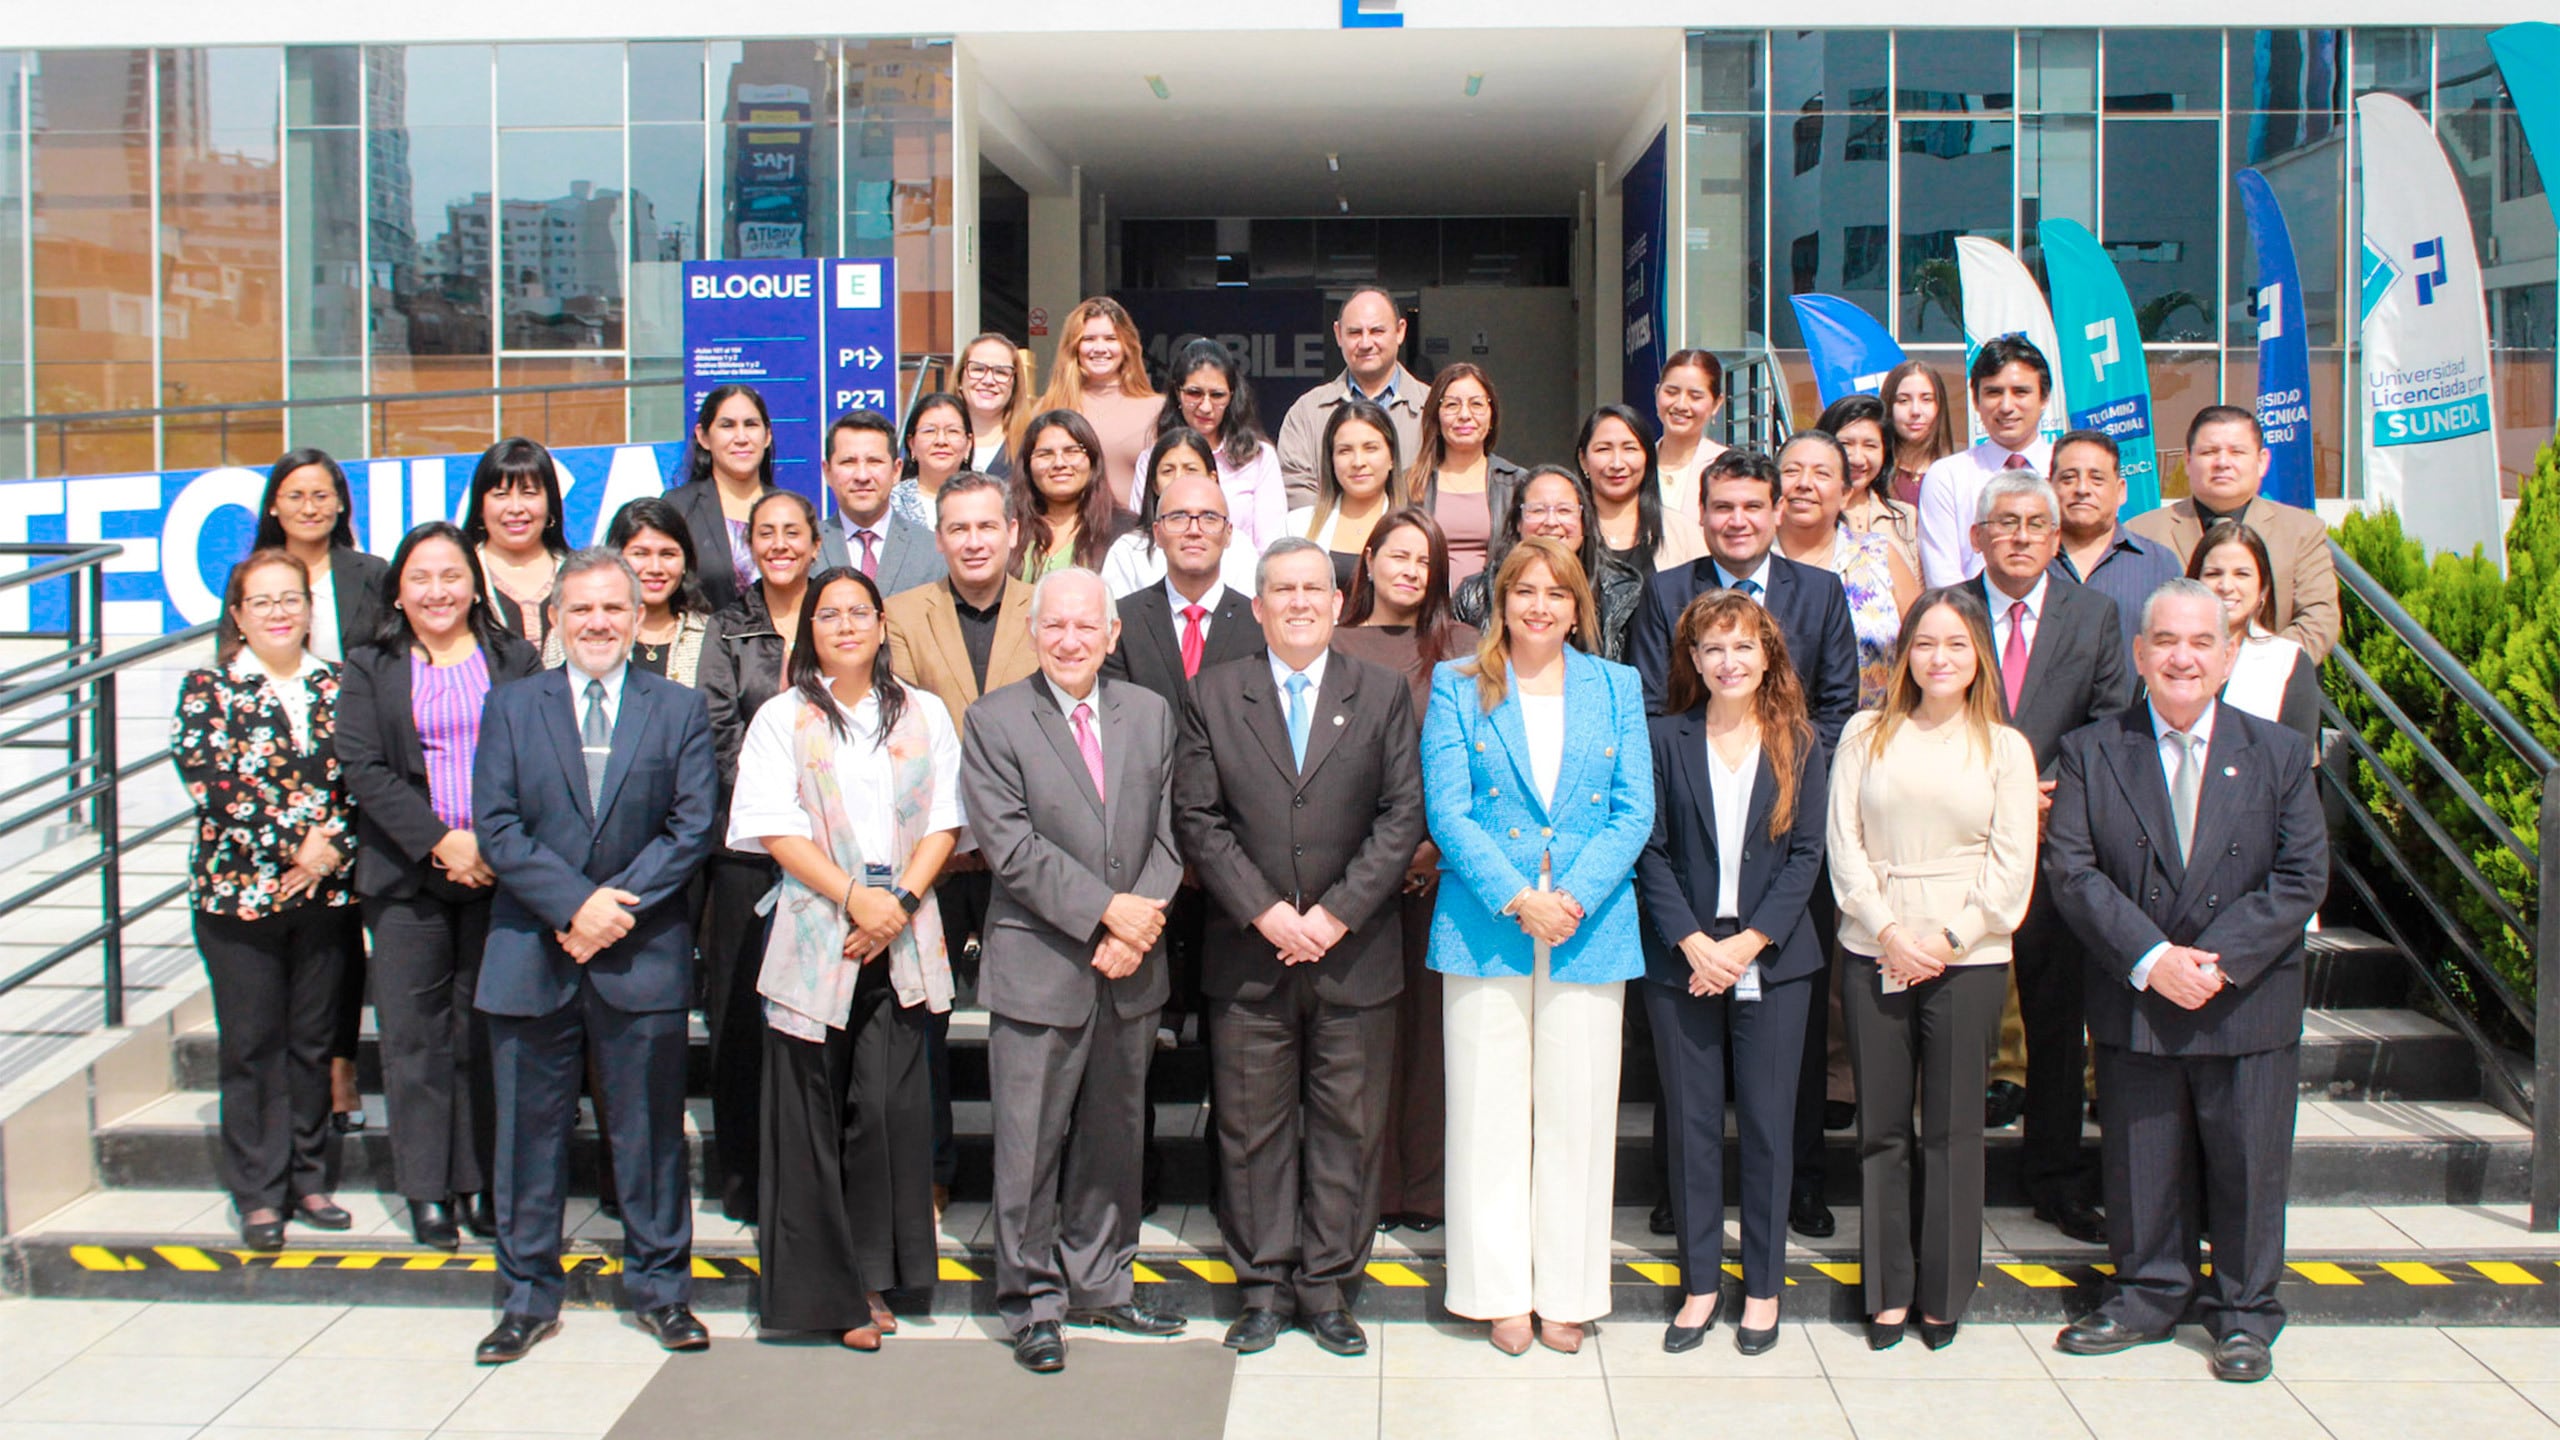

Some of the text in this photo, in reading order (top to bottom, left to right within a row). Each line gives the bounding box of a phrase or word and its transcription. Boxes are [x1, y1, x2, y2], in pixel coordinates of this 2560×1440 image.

[690, 274, 812, 299] BLOQUE
[851, 274, 866, 296] E
[839, 348, 865, 368] P1
[2369, 356, 2465, 388] Universidad
[836, 390, 866, 410] P2
[2371, 375, 2486, 407] Licenciada pr
